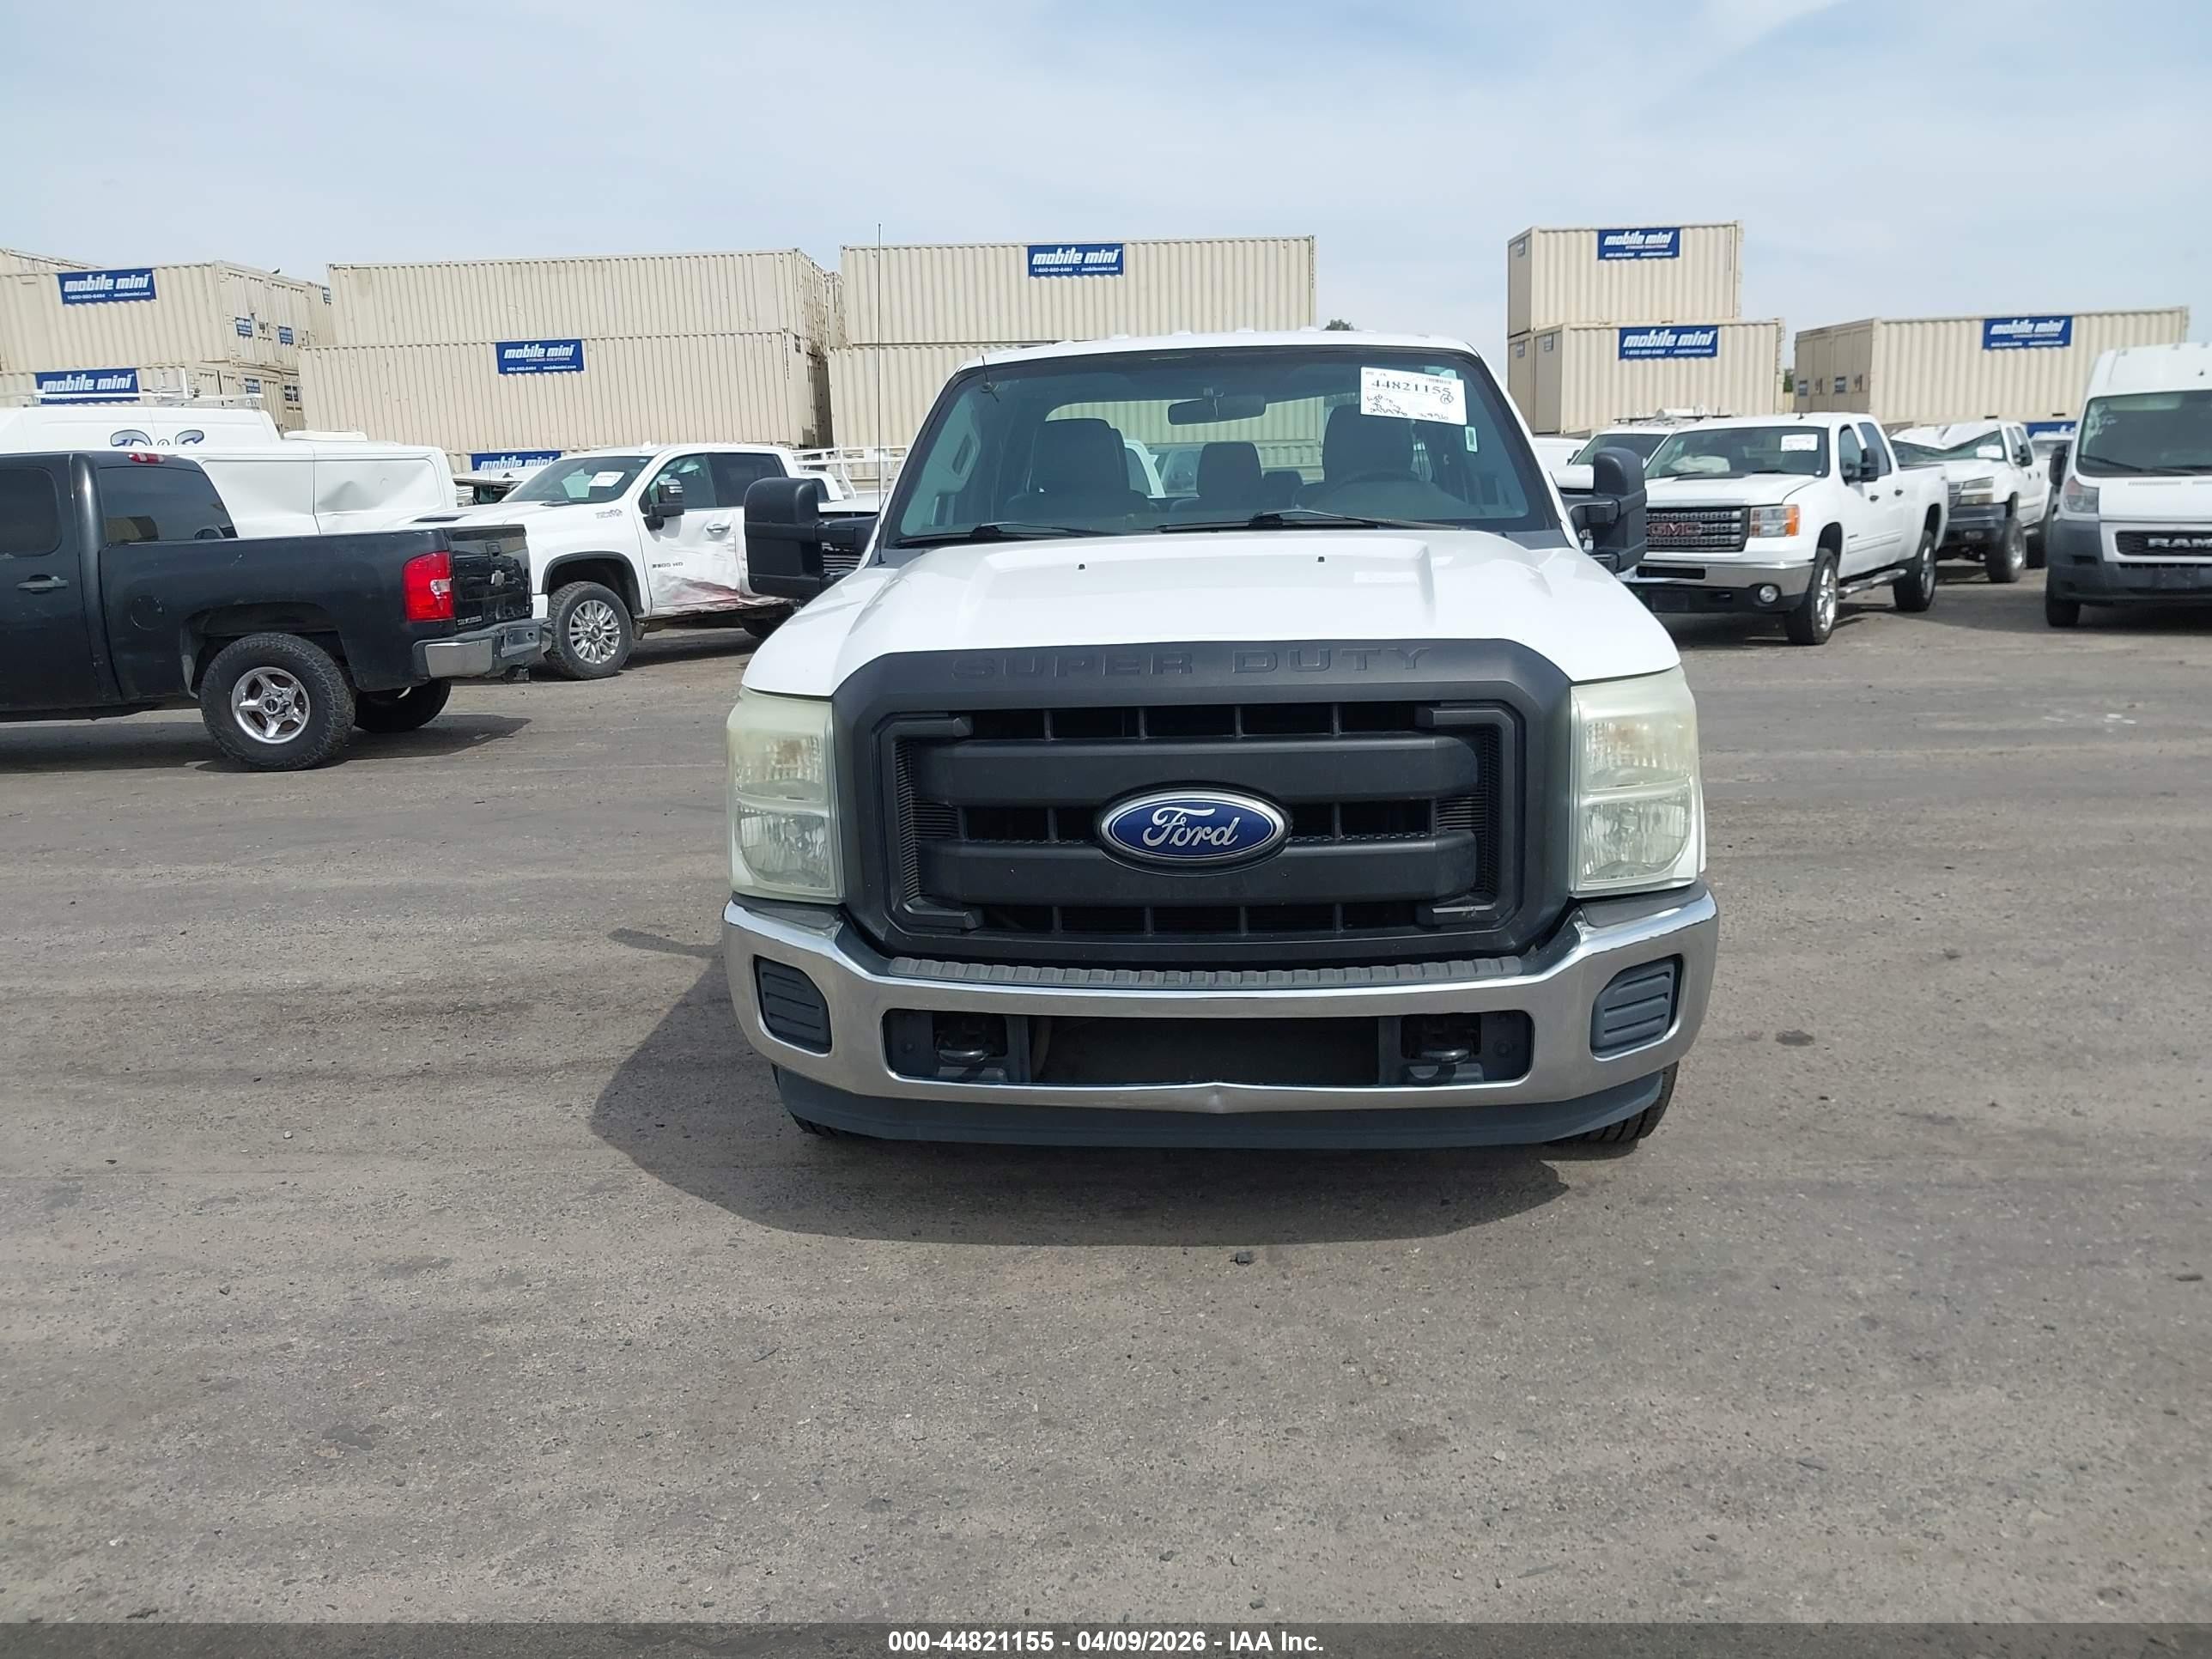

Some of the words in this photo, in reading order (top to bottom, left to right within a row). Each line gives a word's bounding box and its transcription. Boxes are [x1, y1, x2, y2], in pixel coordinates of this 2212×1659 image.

[1604, 230, 1645, 246] mobile
[1644, 231, 1674, 245] mini
[1031, 246, 1083, 265] mobile
[1084, 248, 1120, 264] mini
[64, 273, 114, 292] mobile
[115, 273, 150, 289] mini
[1623, 329, 1677, 348] mobile
[1676, 330, 1715, 346] mini
[503, 343, 545, 359] mobile
[546, 343, 574, 357] mini
[42, 374, 94, 392] mobile
[96, 374, 132, 390] mini
[1371, 380, 1451, 397] 44821155
[479, 455, 523, 471] mobile
[1648, 522, 1701, 537] GMC
[2148, 538, 2212, 548] RAM
[951, 651, 1194, 681] SUPER
[1232, 647, 1430, 674] DUTY
[1142, 806, 1241, 847] Ford
